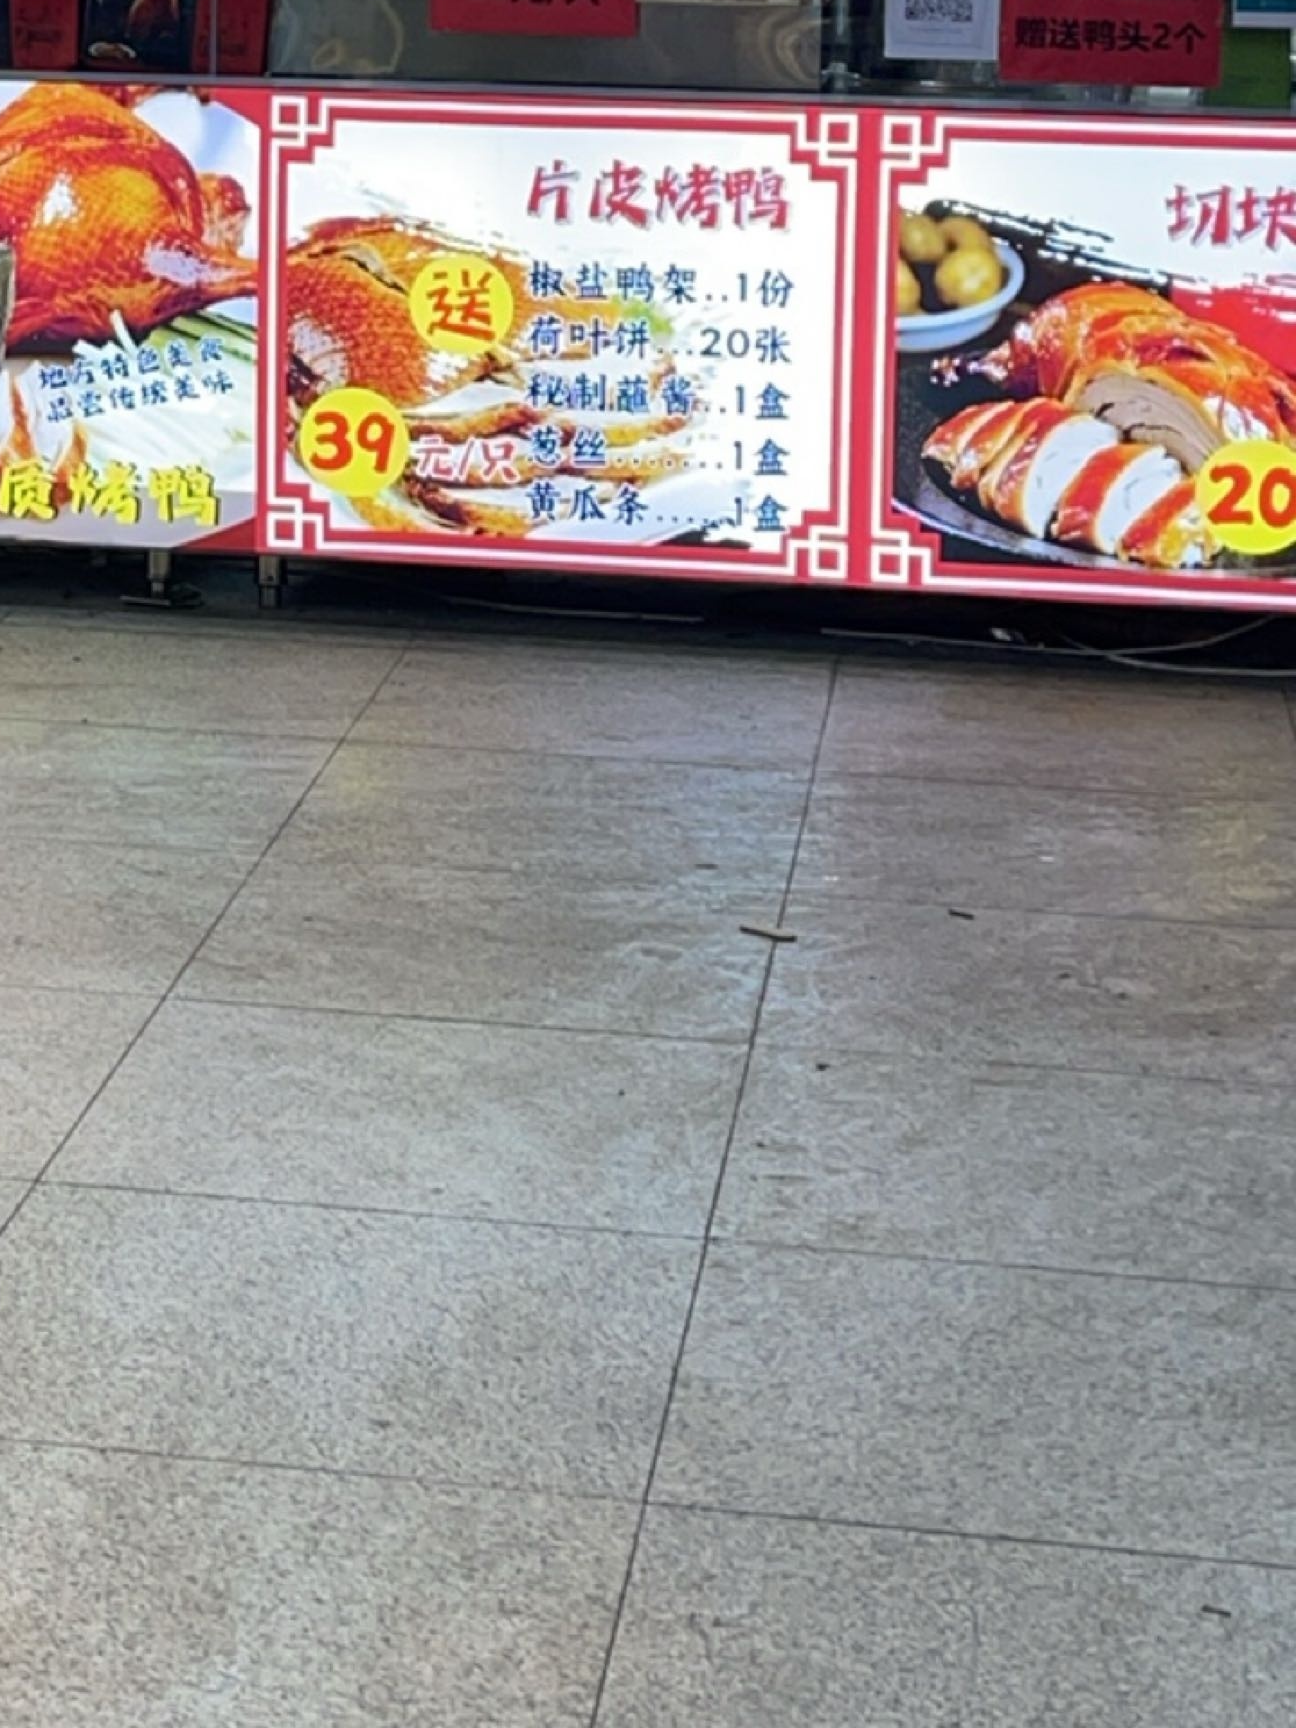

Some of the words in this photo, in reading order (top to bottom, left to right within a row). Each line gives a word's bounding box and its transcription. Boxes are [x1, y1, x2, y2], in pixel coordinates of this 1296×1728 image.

[1014, 18, 1206, 54] 赠送鸭头2个
[526, 159, 792, 231] 片皮烤鸭
[424, 269, 499, 342] 送
[1207, 463, 1296, 529] 20
